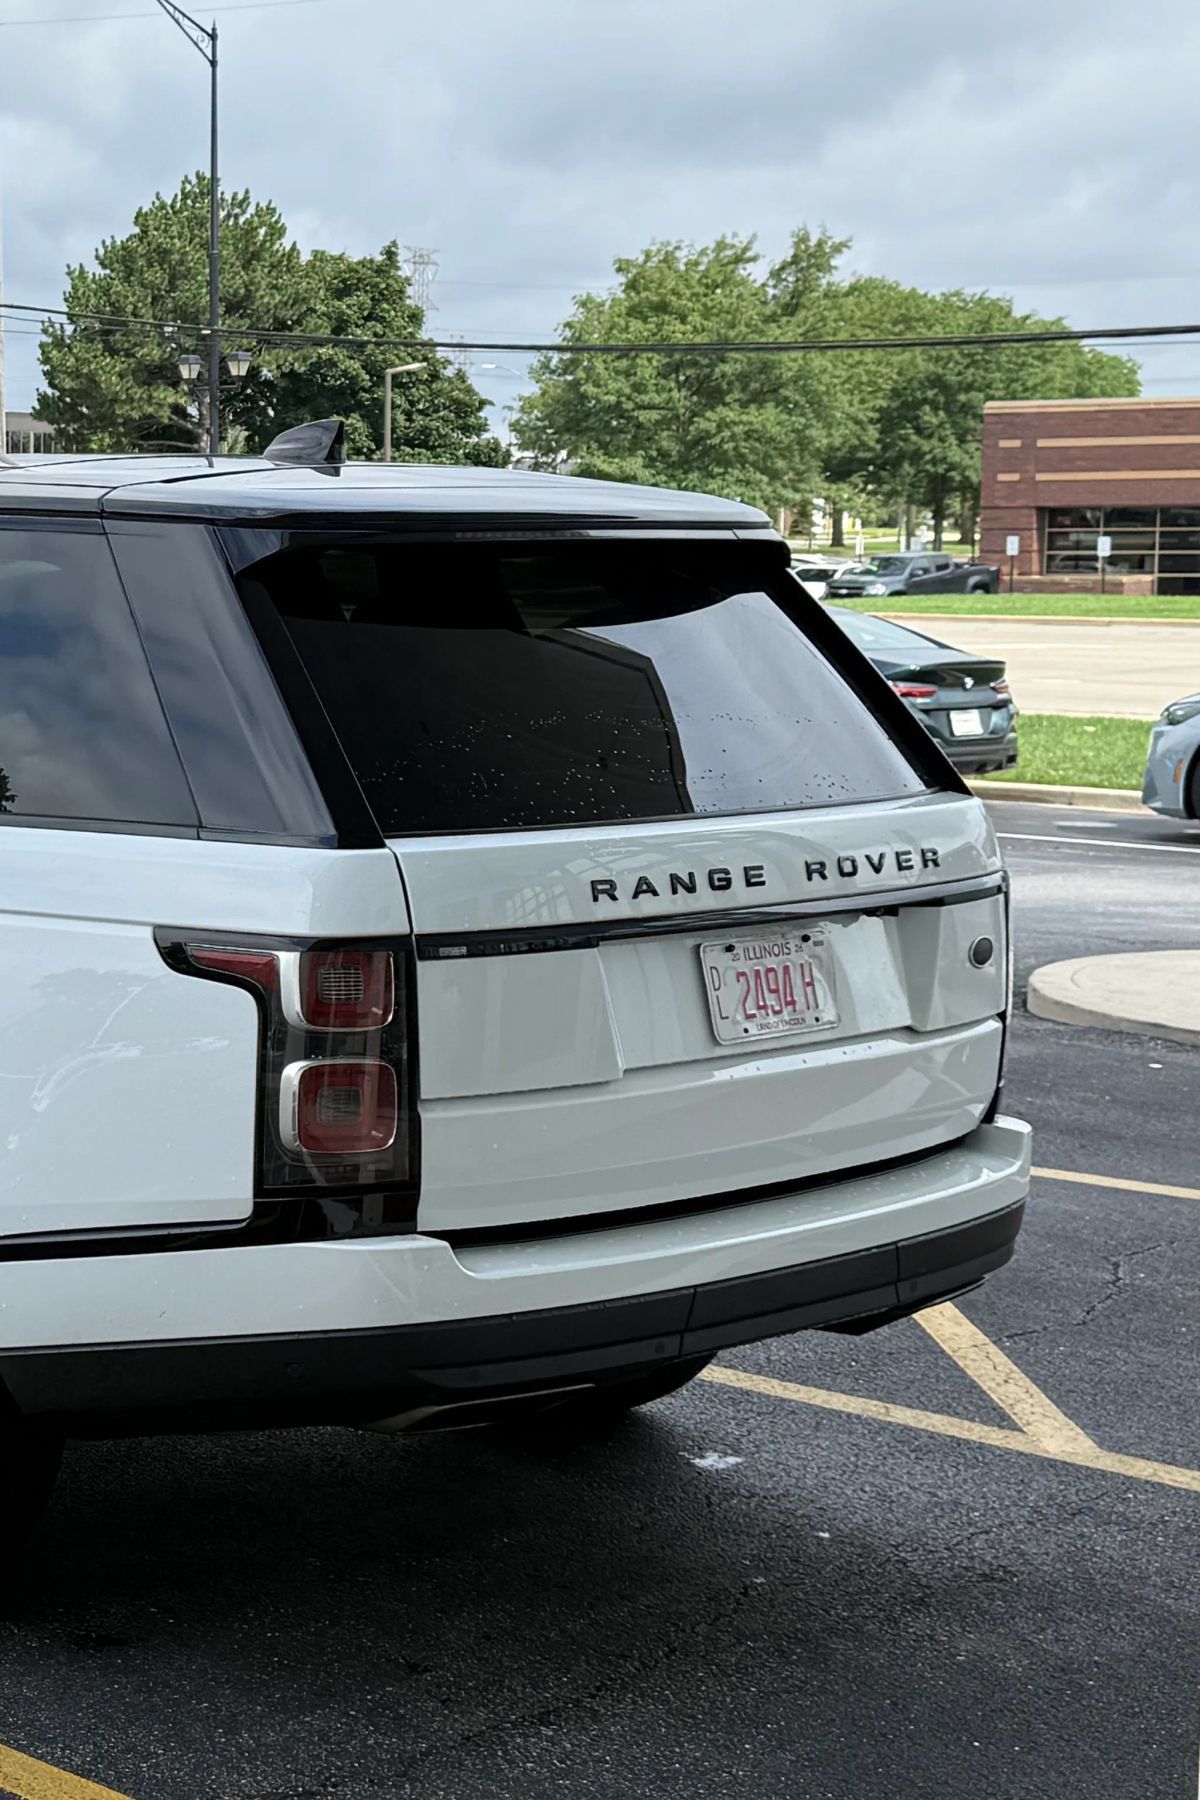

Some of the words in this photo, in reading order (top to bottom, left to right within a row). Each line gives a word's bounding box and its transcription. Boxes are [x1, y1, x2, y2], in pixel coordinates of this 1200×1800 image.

[590, 864, 767, 903] RANGE
[804, 847, 942, 882] ROVER
[743, 942, 792, 960] ILLINOIS
[736, 964, 797, 1019] 2494
[800, 961, 819, 1011] H
